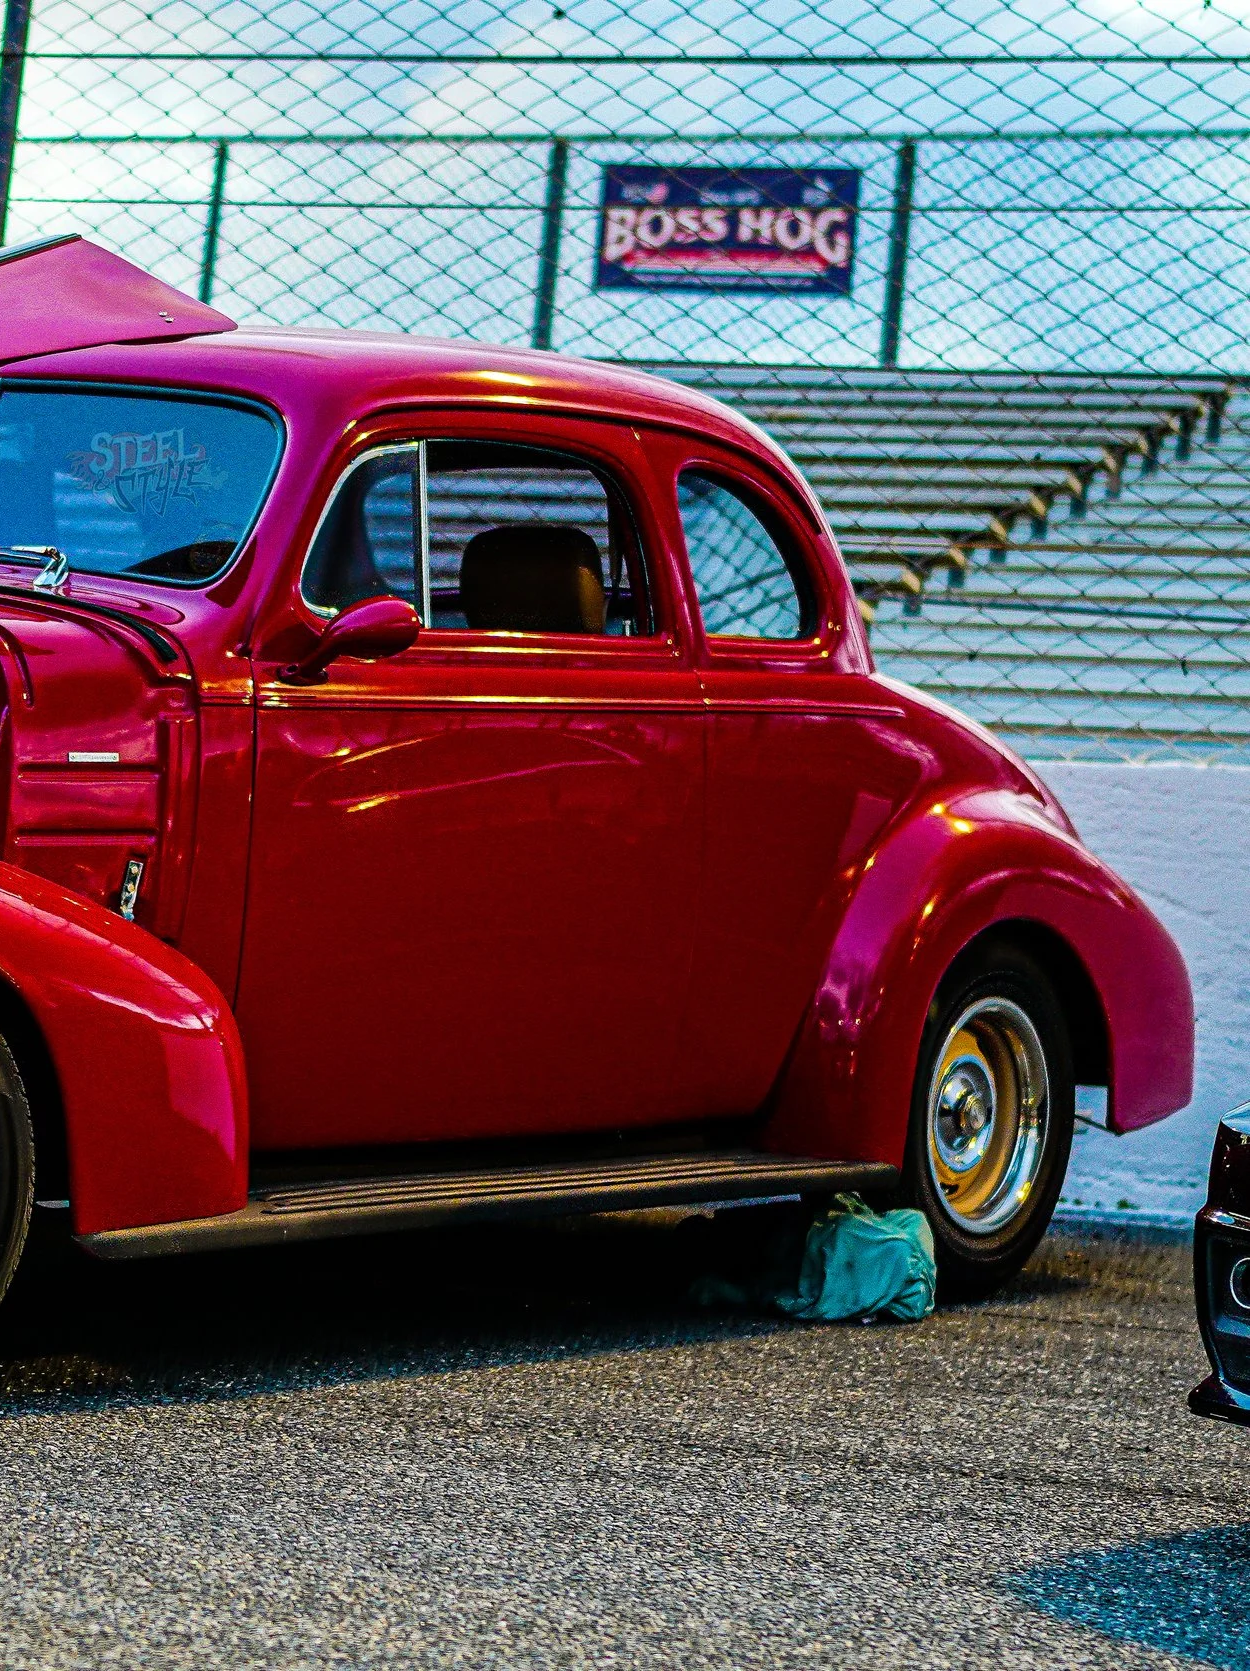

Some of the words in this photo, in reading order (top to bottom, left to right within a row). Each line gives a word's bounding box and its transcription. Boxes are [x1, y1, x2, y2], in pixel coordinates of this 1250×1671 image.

[603, 207, 729, 263] BOSS
[736, 206, 849, 268] HOG
[89, 428, 206, 474] STEEL
